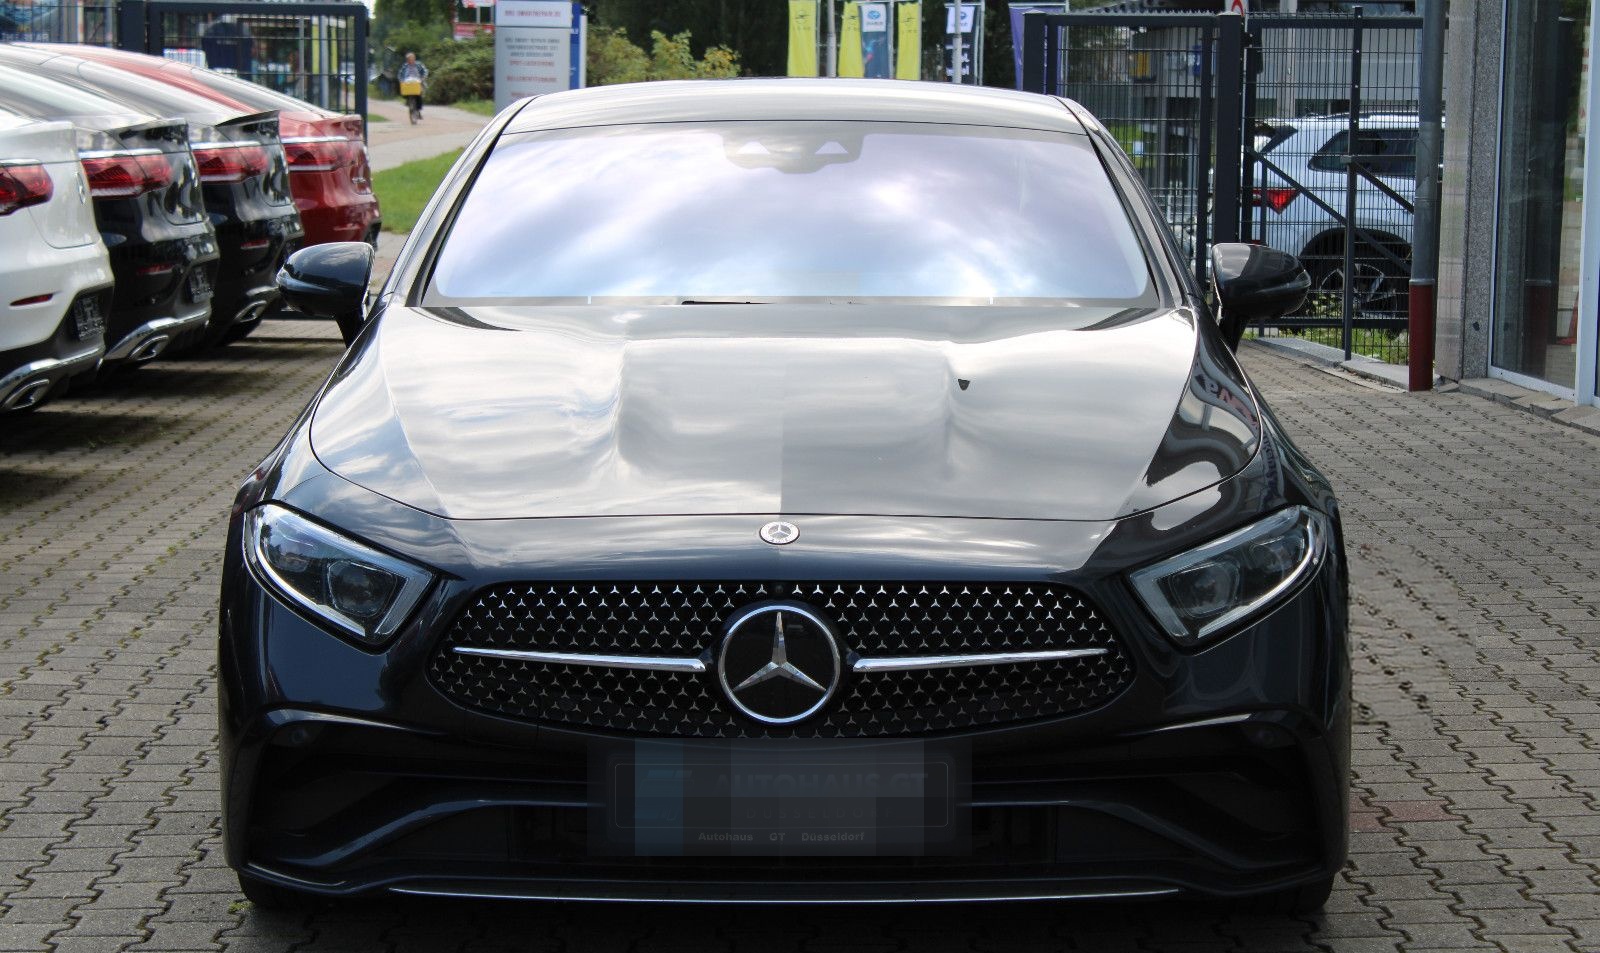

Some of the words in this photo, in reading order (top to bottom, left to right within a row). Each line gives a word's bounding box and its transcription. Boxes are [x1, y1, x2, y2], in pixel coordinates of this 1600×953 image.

[698, 832, 753, 841] Autohaus
[769, 832, 786, 841] GT
[801, 831, 866, 842] Düsseldorf
